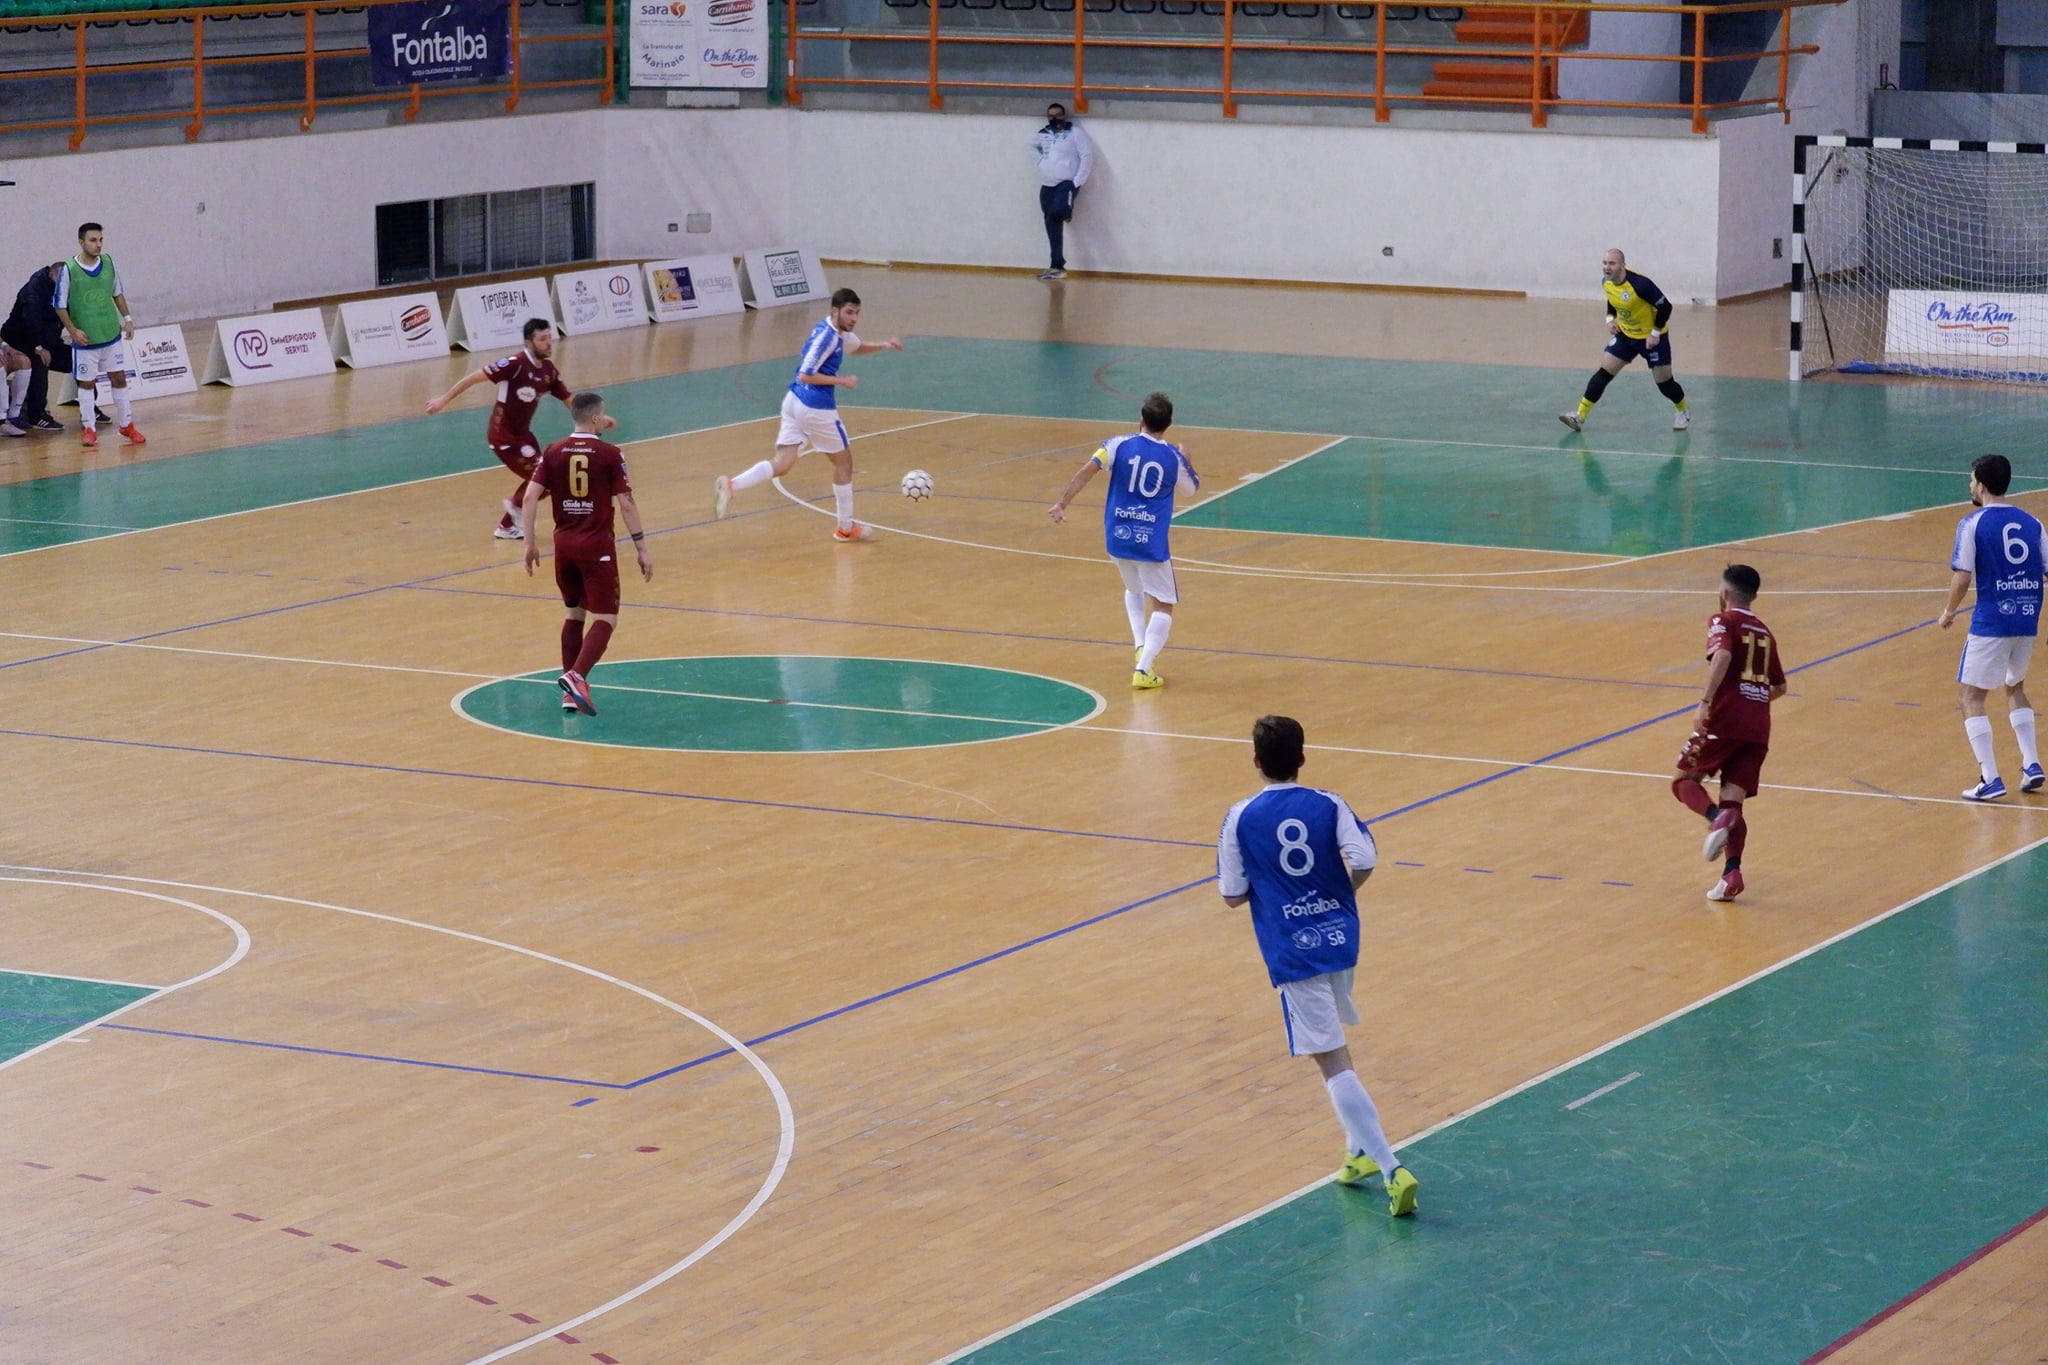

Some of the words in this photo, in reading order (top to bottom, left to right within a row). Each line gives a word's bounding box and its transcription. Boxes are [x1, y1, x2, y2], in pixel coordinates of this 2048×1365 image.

[641, 5, 669, 15] sara
[392, 26, 488, 67] Fontalba
[642, 53, 685, 69] Marinaio
[703, 48, 719, 62] On
[719, 49, 736, 62] the
[736, 48, 759, 63] Run
[481, 290, 530, 313] TIPOGRAFIA
[1927, 301, 1952, 321] On
[1955, 303, 1980, 322] the
[1978, 302, 2017, 325] Run
[270, 332, 317, 345] EMMEPIGROUP
[285, 345, 309, 355] SERVIZI
[569, 455, 589, 498] 6
[1128, 455, 1164, 498] 10
[1115, 507, 1156, 523] Fontalba
[1135, 533, 1149, 544] SB
[2002, 522, 2029, 565] 6
[1996, 579, 2039, 591] Fontalba
[2022, 604, 2035, 615] SB
[1741, 632, 1770, 685] 11
[1276, 818, 1315, 877] 8
[1281, 897, 1341, 920] Fontalba
[1327, 929, 1346, 946] SB
